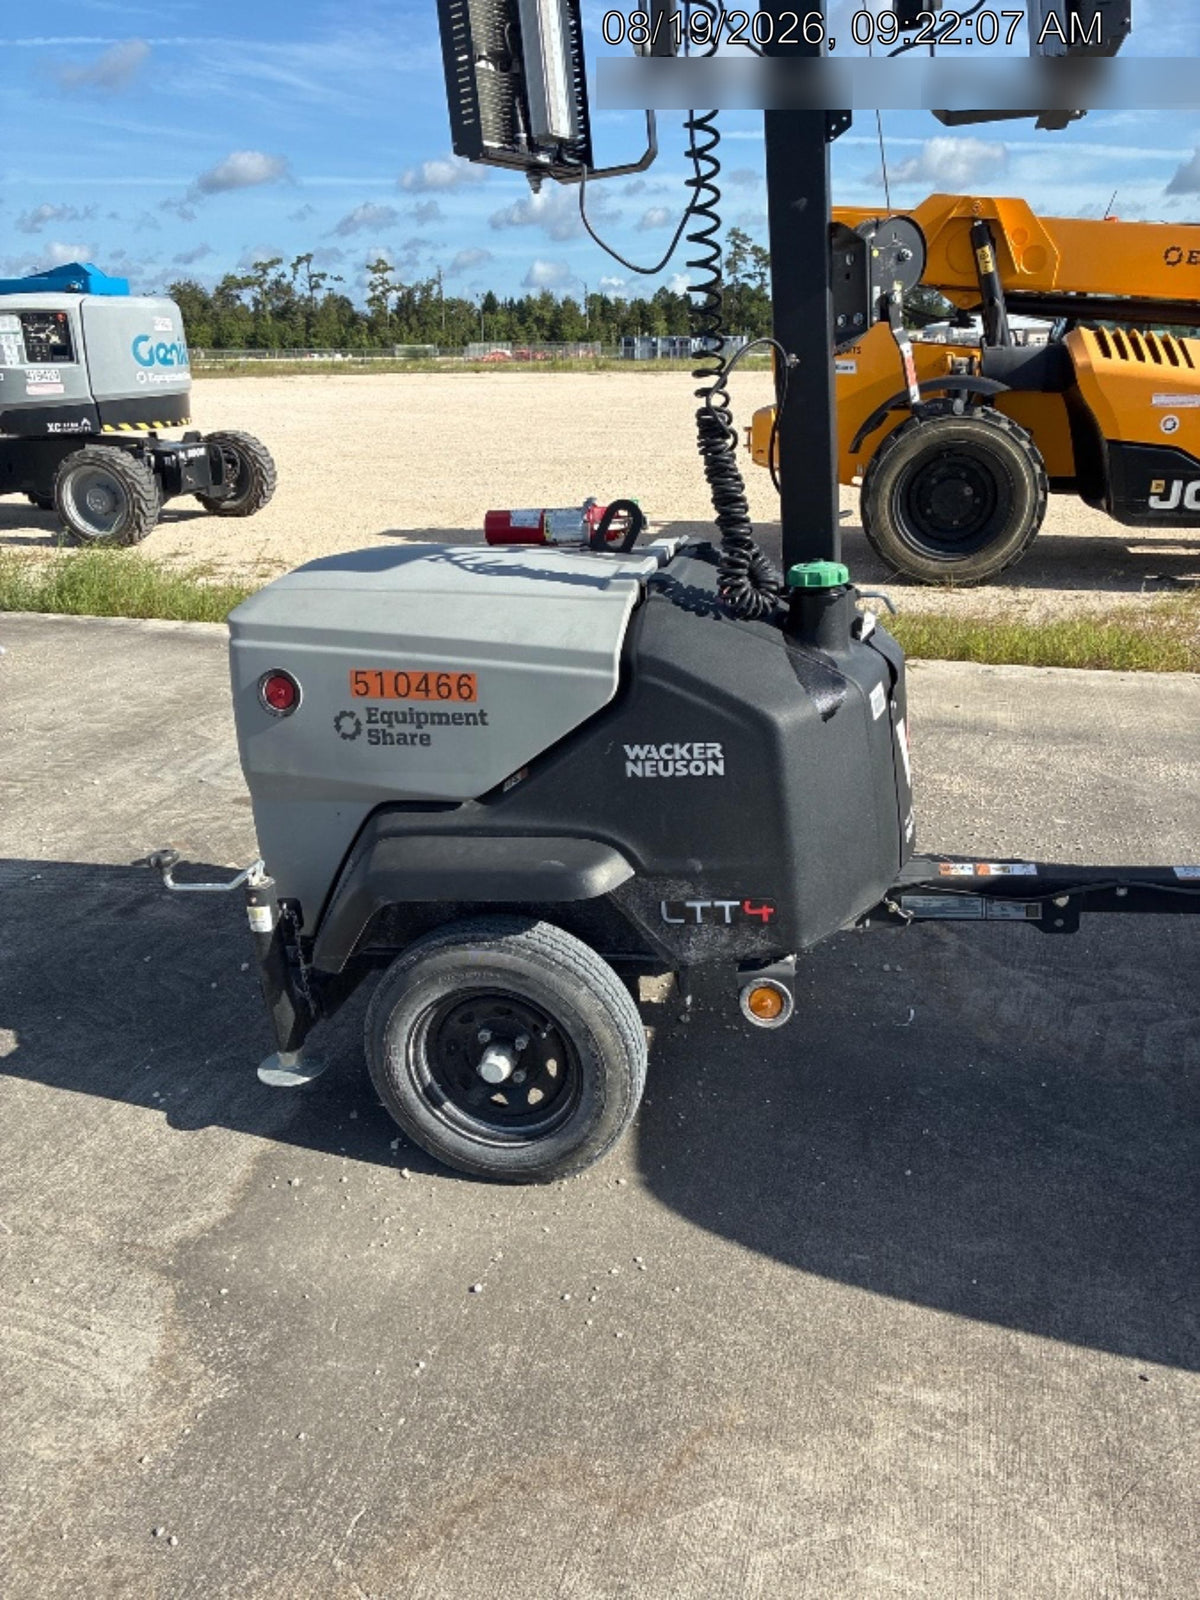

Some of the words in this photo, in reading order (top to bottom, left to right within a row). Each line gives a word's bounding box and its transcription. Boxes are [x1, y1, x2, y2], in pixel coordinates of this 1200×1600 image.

[354, 671, 474, 700] 510466
[366, 707, 489, 729] Equipment
[367, 728, 432, 747] Share
[623, 742, 725, 760] WACKER
[625, 759, 725, 778] NEUSON
[660, 899, 775, 924] LTT4
